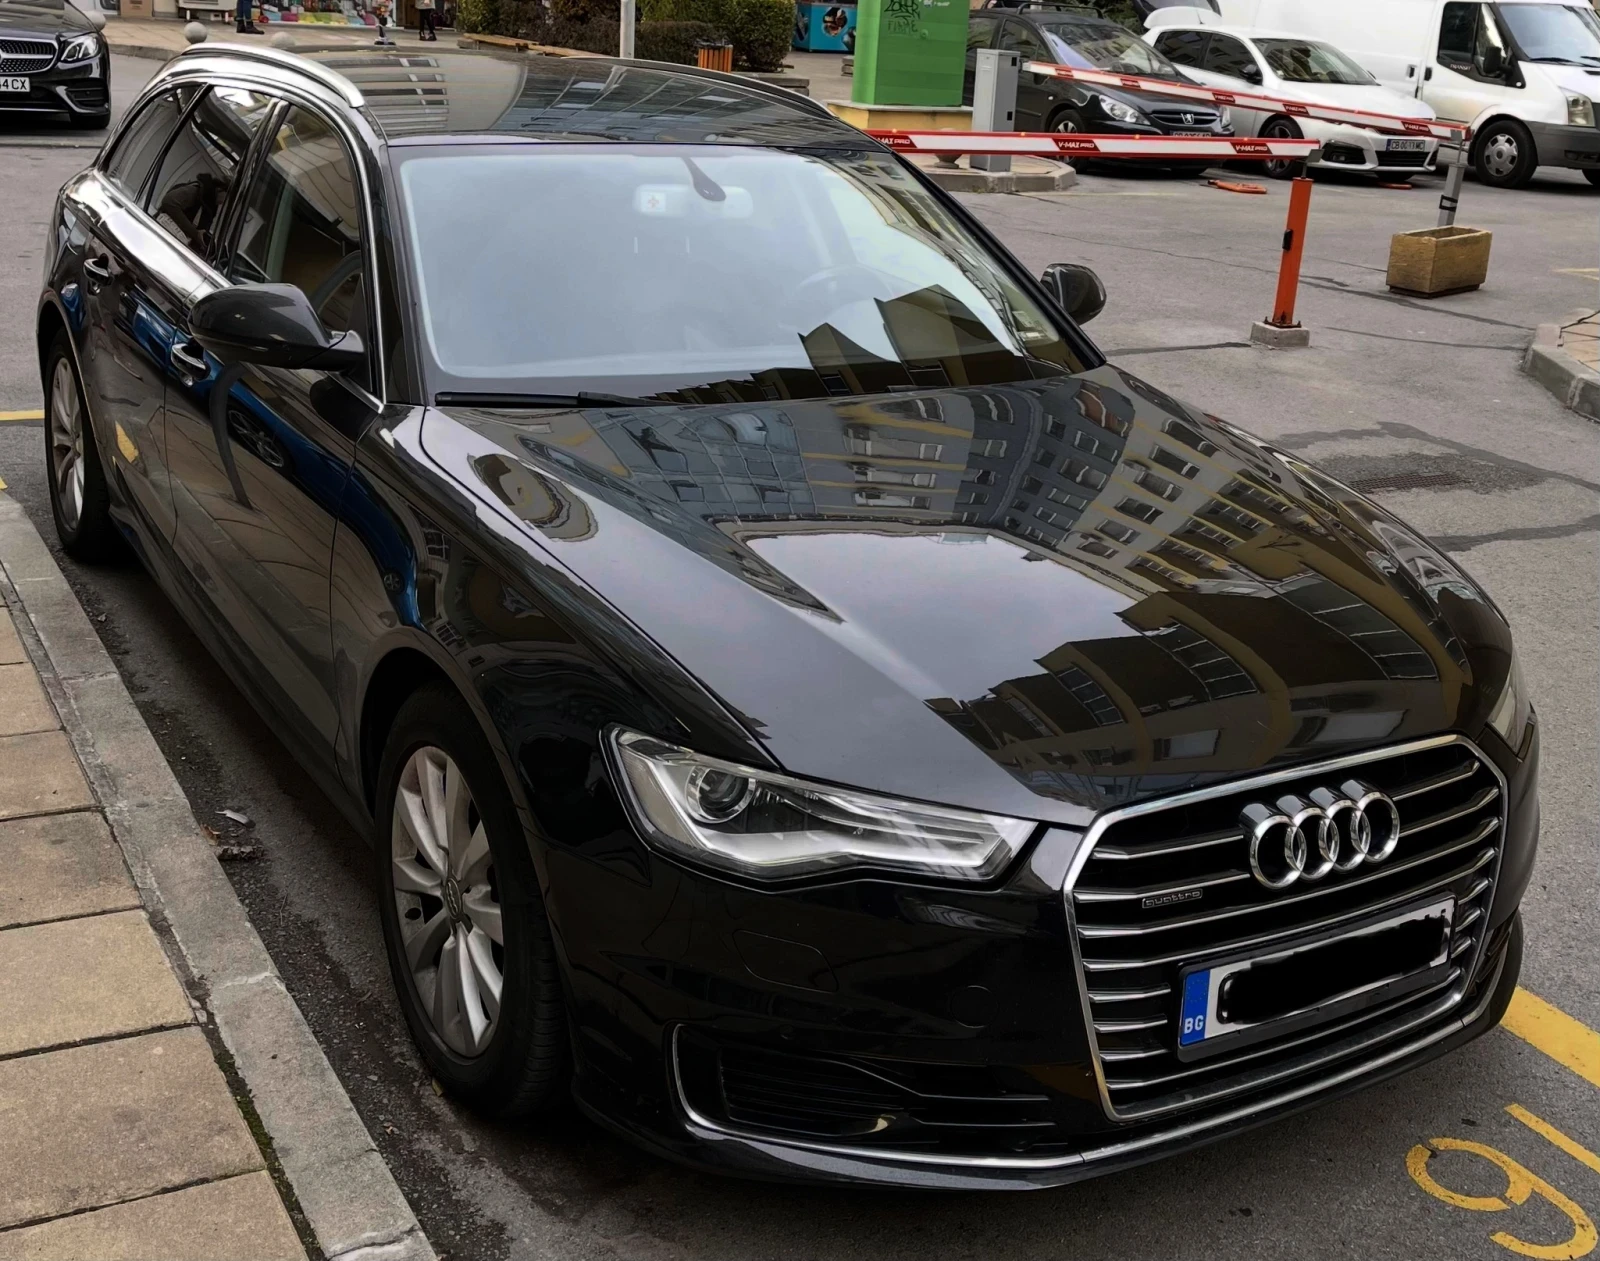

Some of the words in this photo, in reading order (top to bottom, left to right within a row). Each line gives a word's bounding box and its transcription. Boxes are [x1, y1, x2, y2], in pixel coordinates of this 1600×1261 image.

[1449, 63, 1472, 71] TRANSIT
[11, 78, 27, 90] CX
[1145, 890, 1201, 907] quattro
[1183, 1014, 1204, 1035] BG
